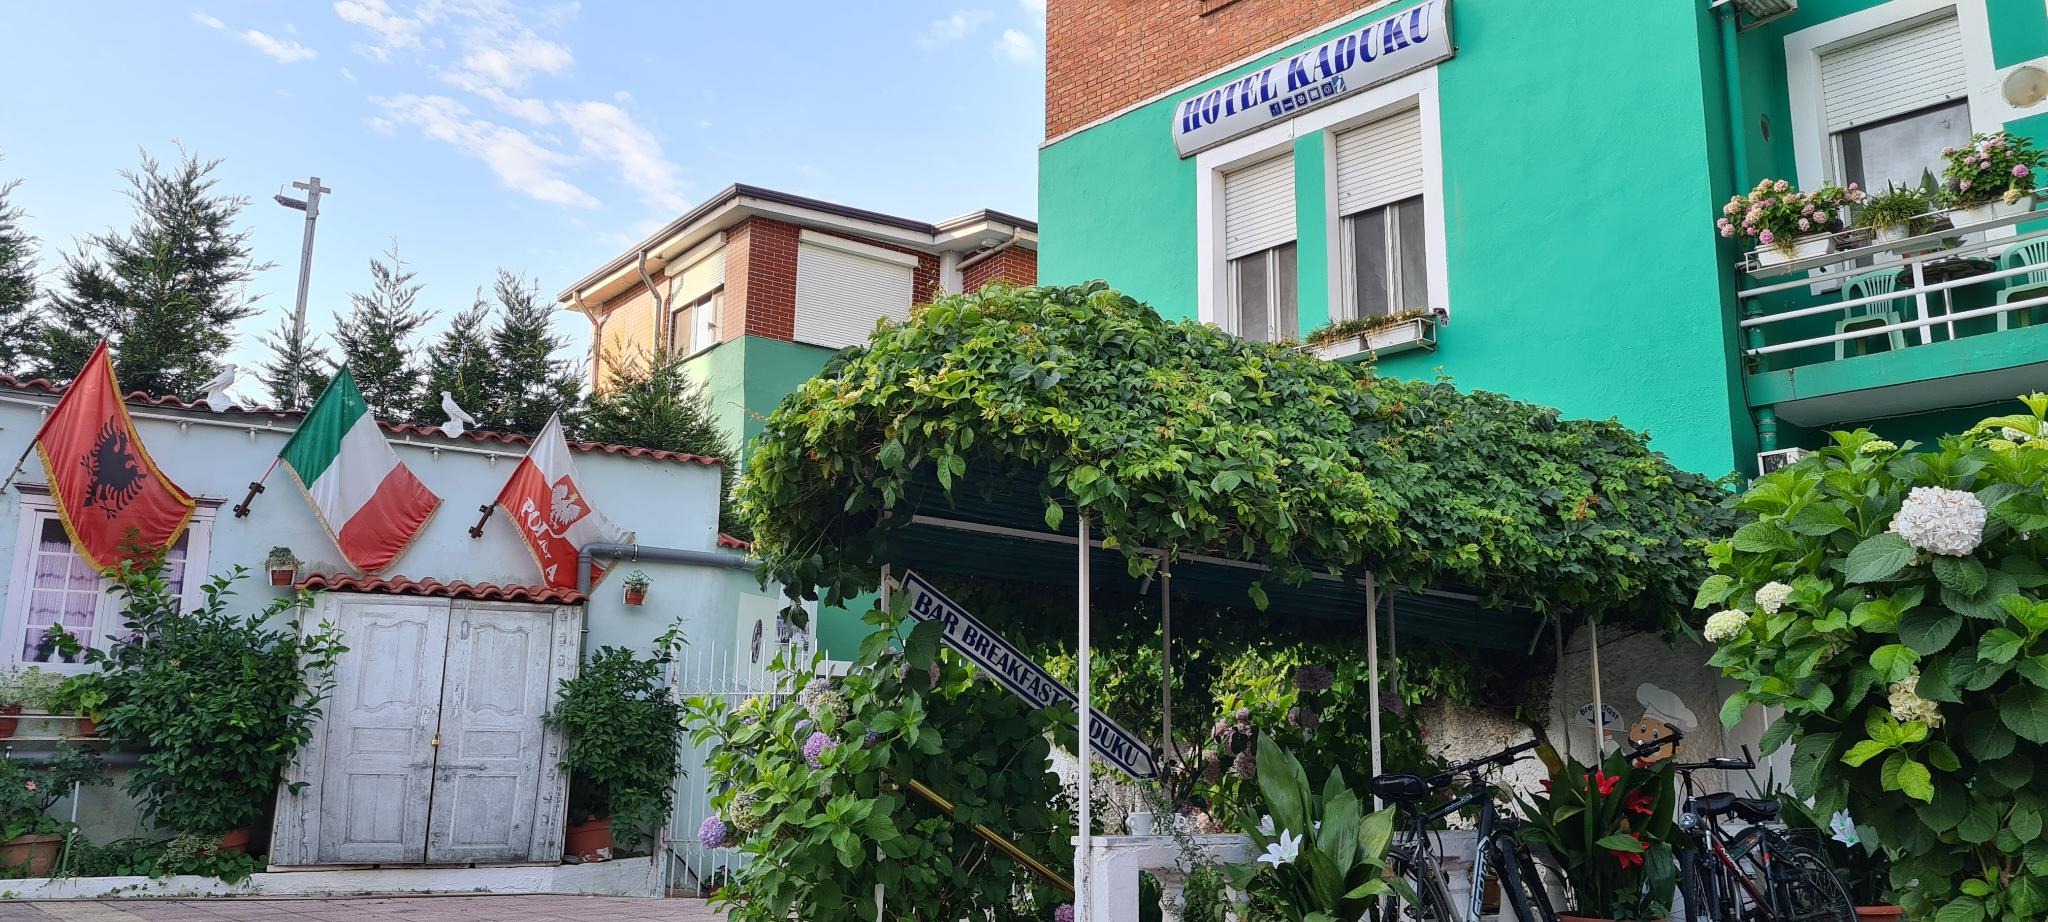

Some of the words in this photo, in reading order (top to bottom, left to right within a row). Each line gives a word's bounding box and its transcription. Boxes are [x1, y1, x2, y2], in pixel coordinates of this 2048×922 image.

[1181, 68, 1278, 134] HOTEL
[1287, 2, 1434, 92] KADUKU
[914, 591, 959, 635] BAR
[962, 624, 1064, 707] BREAKFAST
[1580, 704, 1619, 720] Brefast
